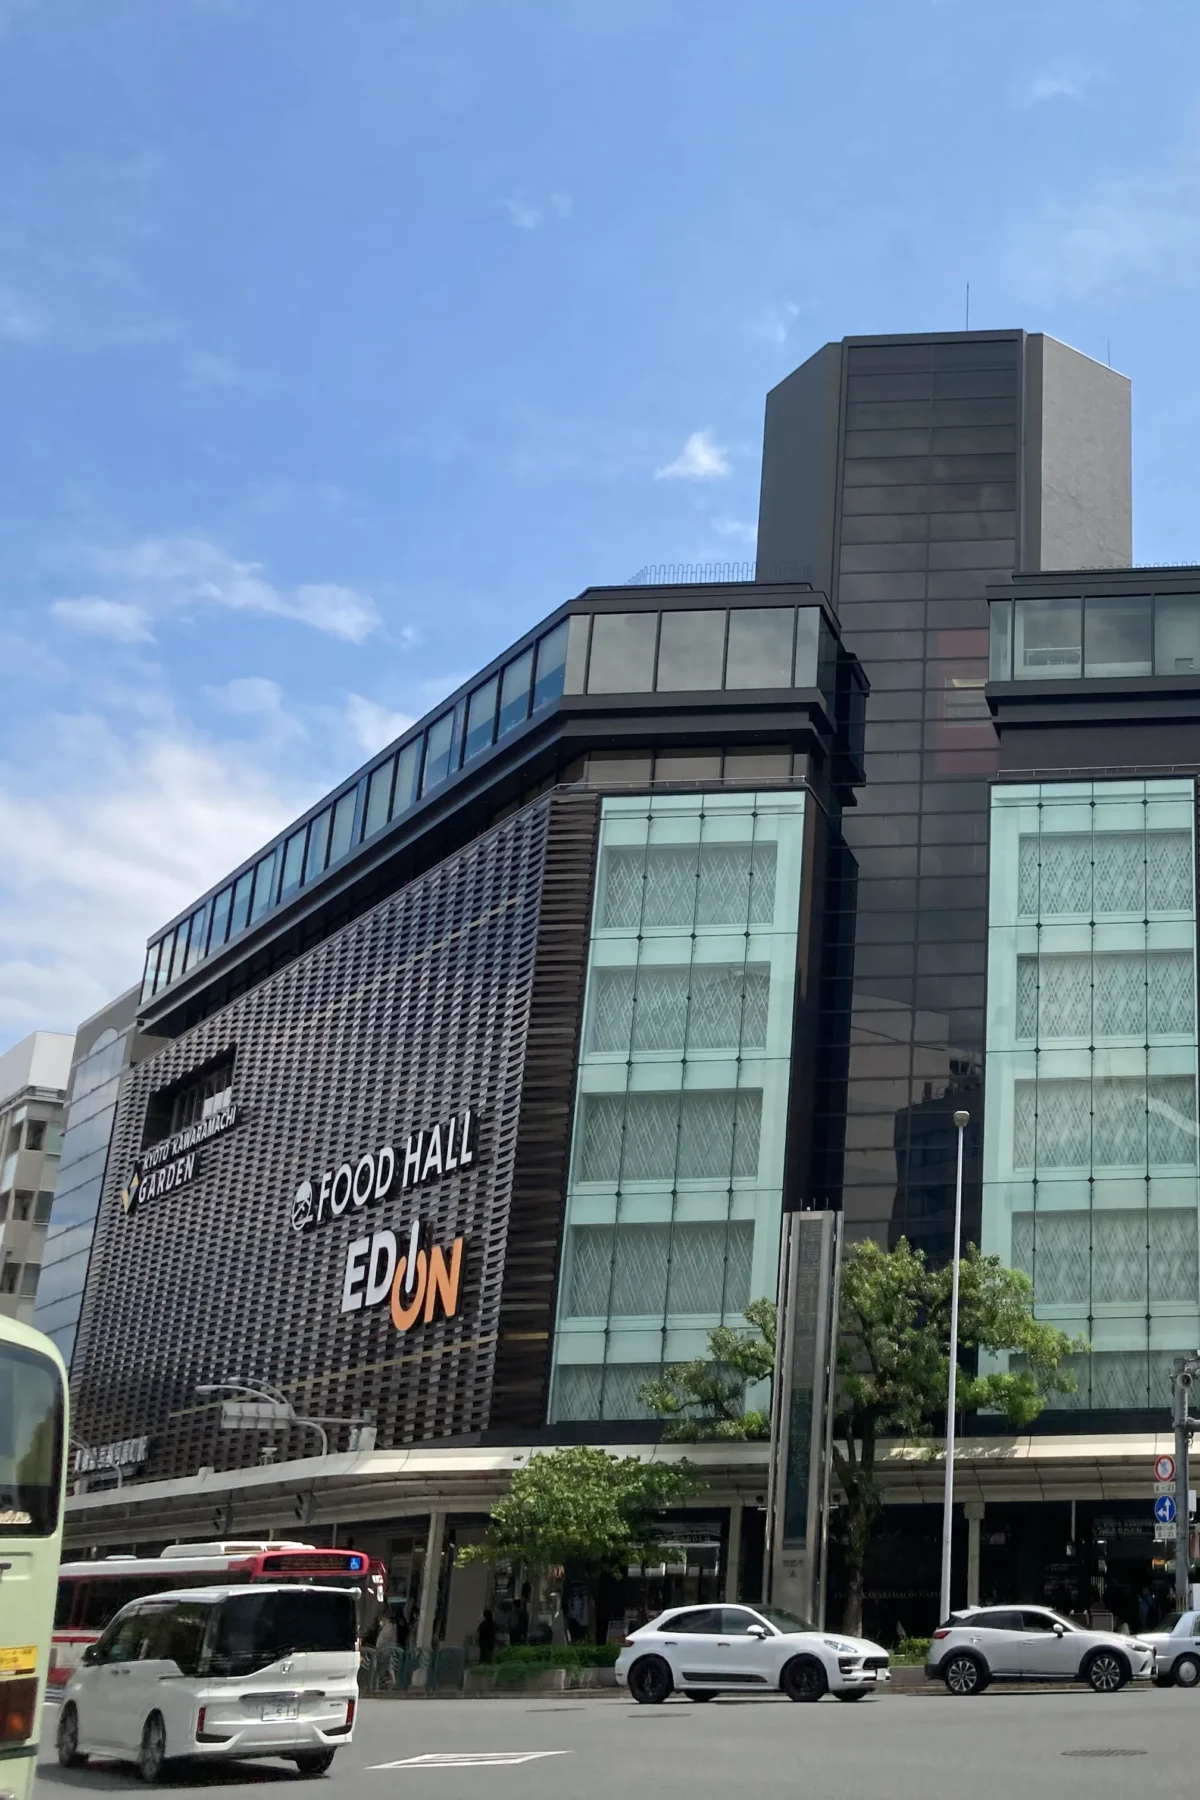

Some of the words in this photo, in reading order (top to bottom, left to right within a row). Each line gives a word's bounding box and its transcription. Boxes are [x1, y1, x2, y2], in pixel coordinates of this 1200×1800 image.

[138, 1152, 195, 1203] GARDEN
[143, 1143, 169, 1171] KYOTO
[171, 1105, 237, 1156] KAWARAMACHI
[316, 1146, 395, 1222] FOOD
[402, 1110, 473, 1188] HALL
[341, 1219, 464, 1331] EDION
